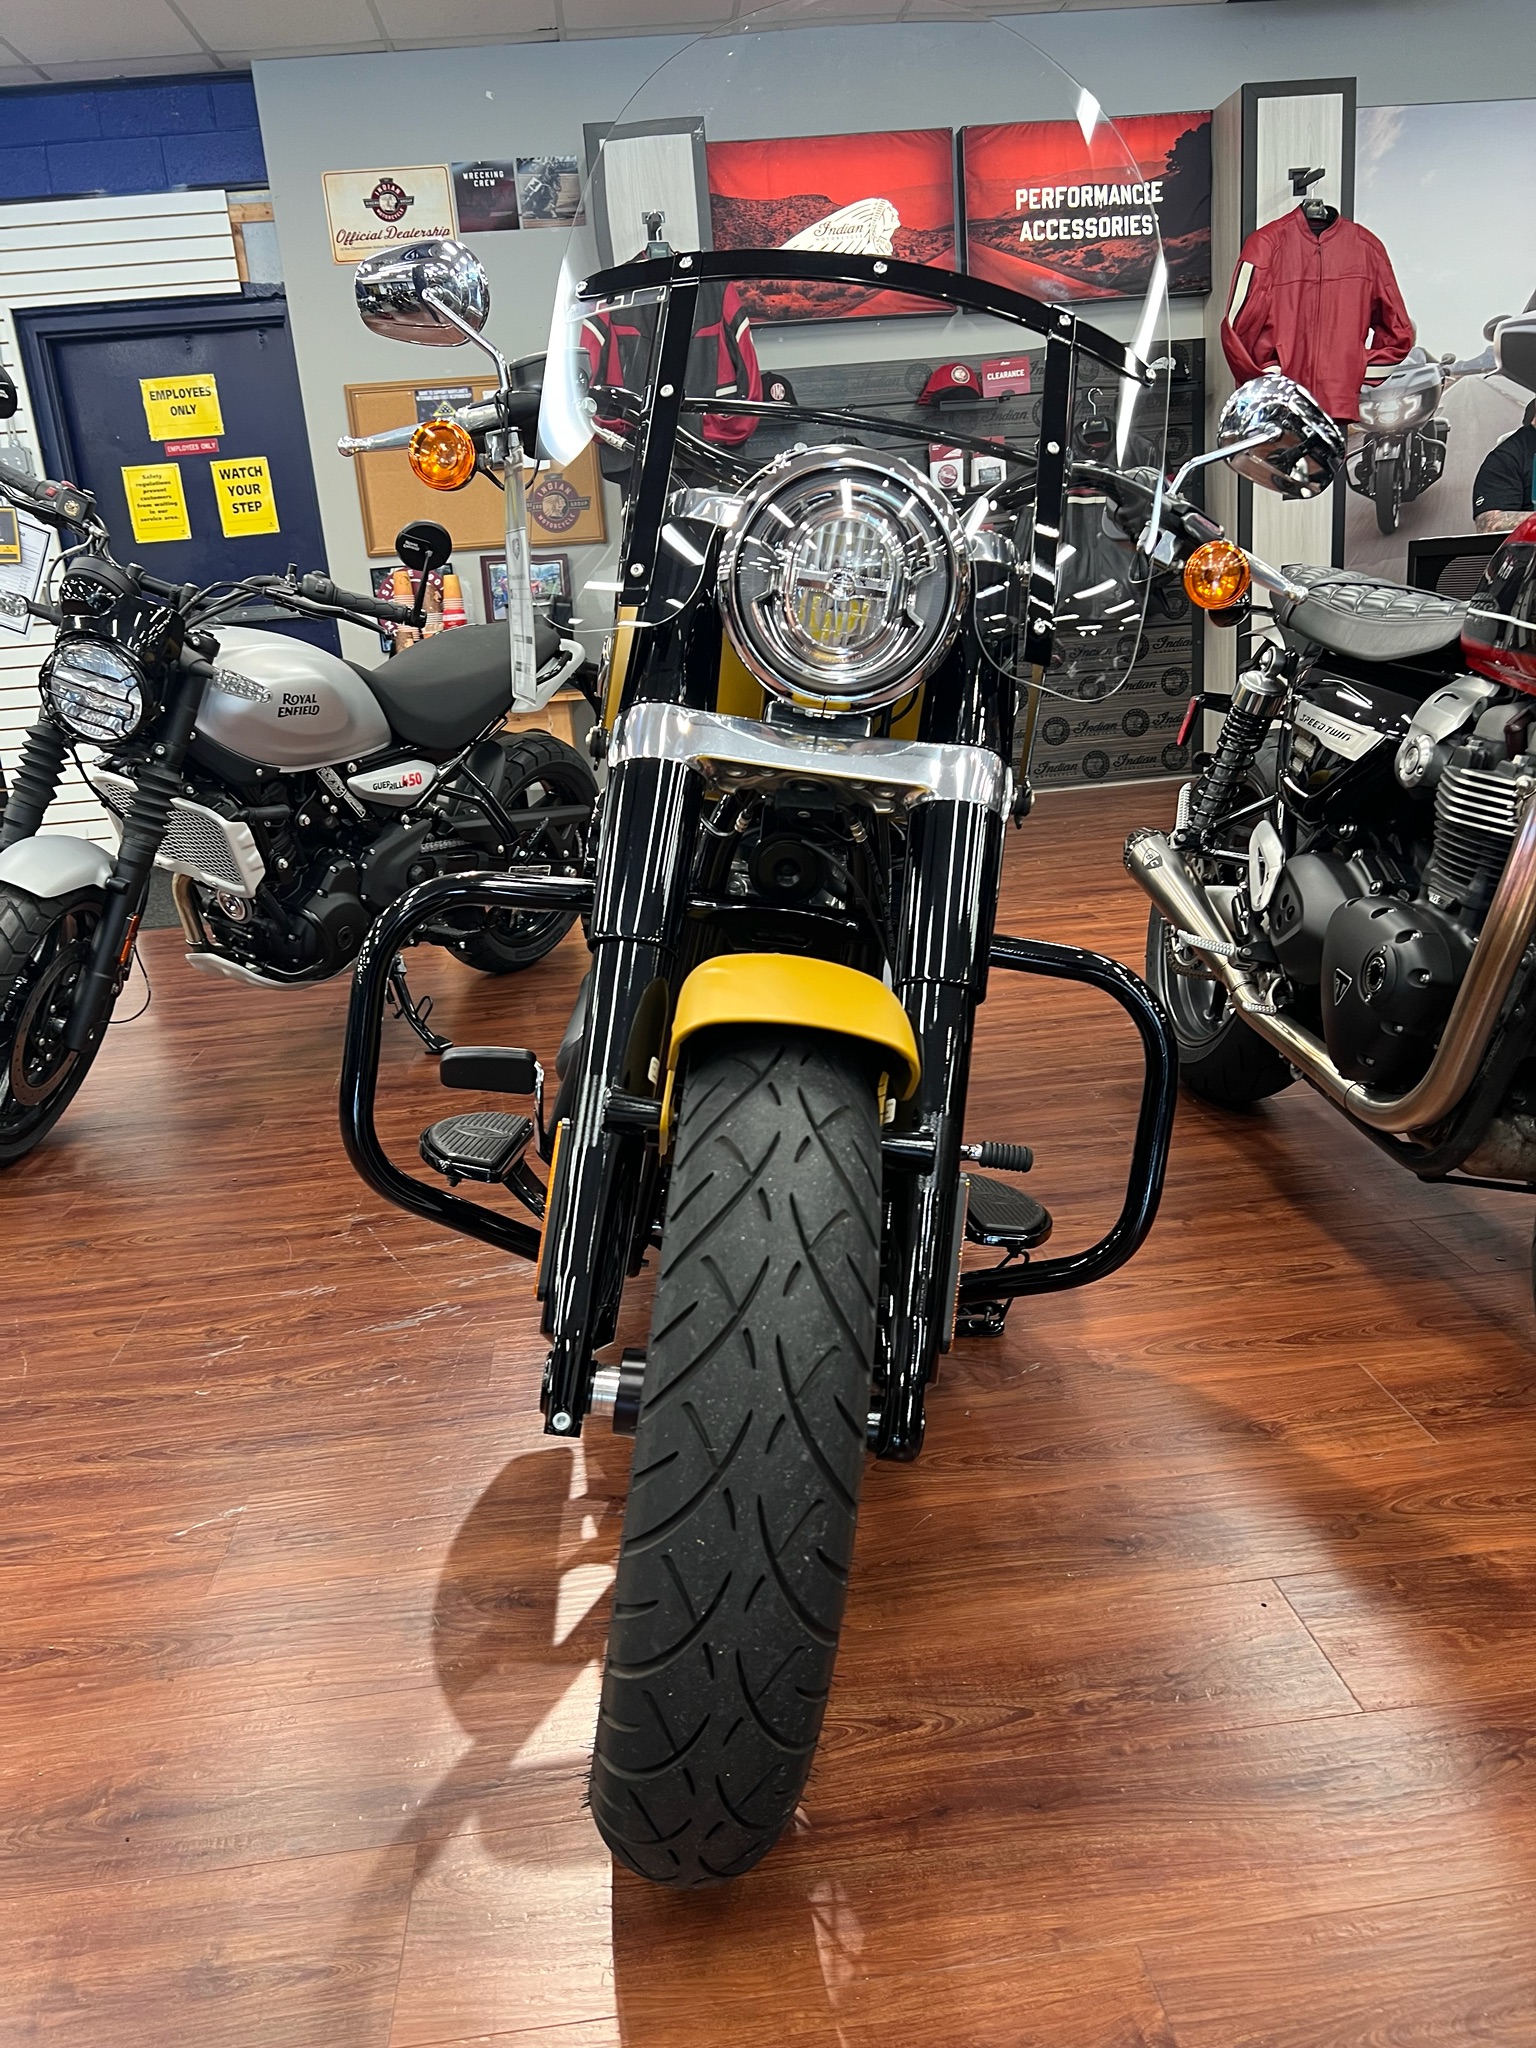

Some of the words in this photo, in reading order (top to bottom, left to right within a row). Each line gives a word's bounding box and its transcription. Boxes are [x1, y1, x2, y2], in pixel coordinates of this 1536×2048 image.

[462, 170, 504, 180] WRECKING
[375, 183, 401, 196] INDIAN
[473, 179, 496, 187] CREW
[1015, 181, 1164, 211] PERFORMANCE
[336, 228, 383, 246] Official
[384, 225, 451, 241] Dealership
[814, 221, 864, 237] Indian
[1019, 215, 1160, 242] ACCESSORIES
[986, 368, 1025, 381] CLEARANCE
[149, 386, 212, 401] EMPLOYEES
[170, 404, 197, 416] ONLY
[167, 443, 200, 453] EMPLOYEES
[200, 442, 216, 450] ONLY
[219, 465, 263, 480] WATCH
[227, 483, 261, 497] YOUR
[537, 482, 572, 497] INDIAN
[232, 500, 262, 514] STEP
[537, 513, 576, 529] MOTORCYCLE
[1152, 635, 1192, 650] India
[282, 693, 317, 705] ROYAL
[277, 705, 320, 718] ENFIELD
[1152, 711, 1185, 725] Indi
[1073, 720, 1118, 734] Indian
[1299, 714, 1326, 731] SPEED
[1324, 726, 1353, 741] TWIN
[1113, 753, 1157, 767] Indian
[1033, 761, 1078, 775] Indian
[402, 772, 422, 787] 450
